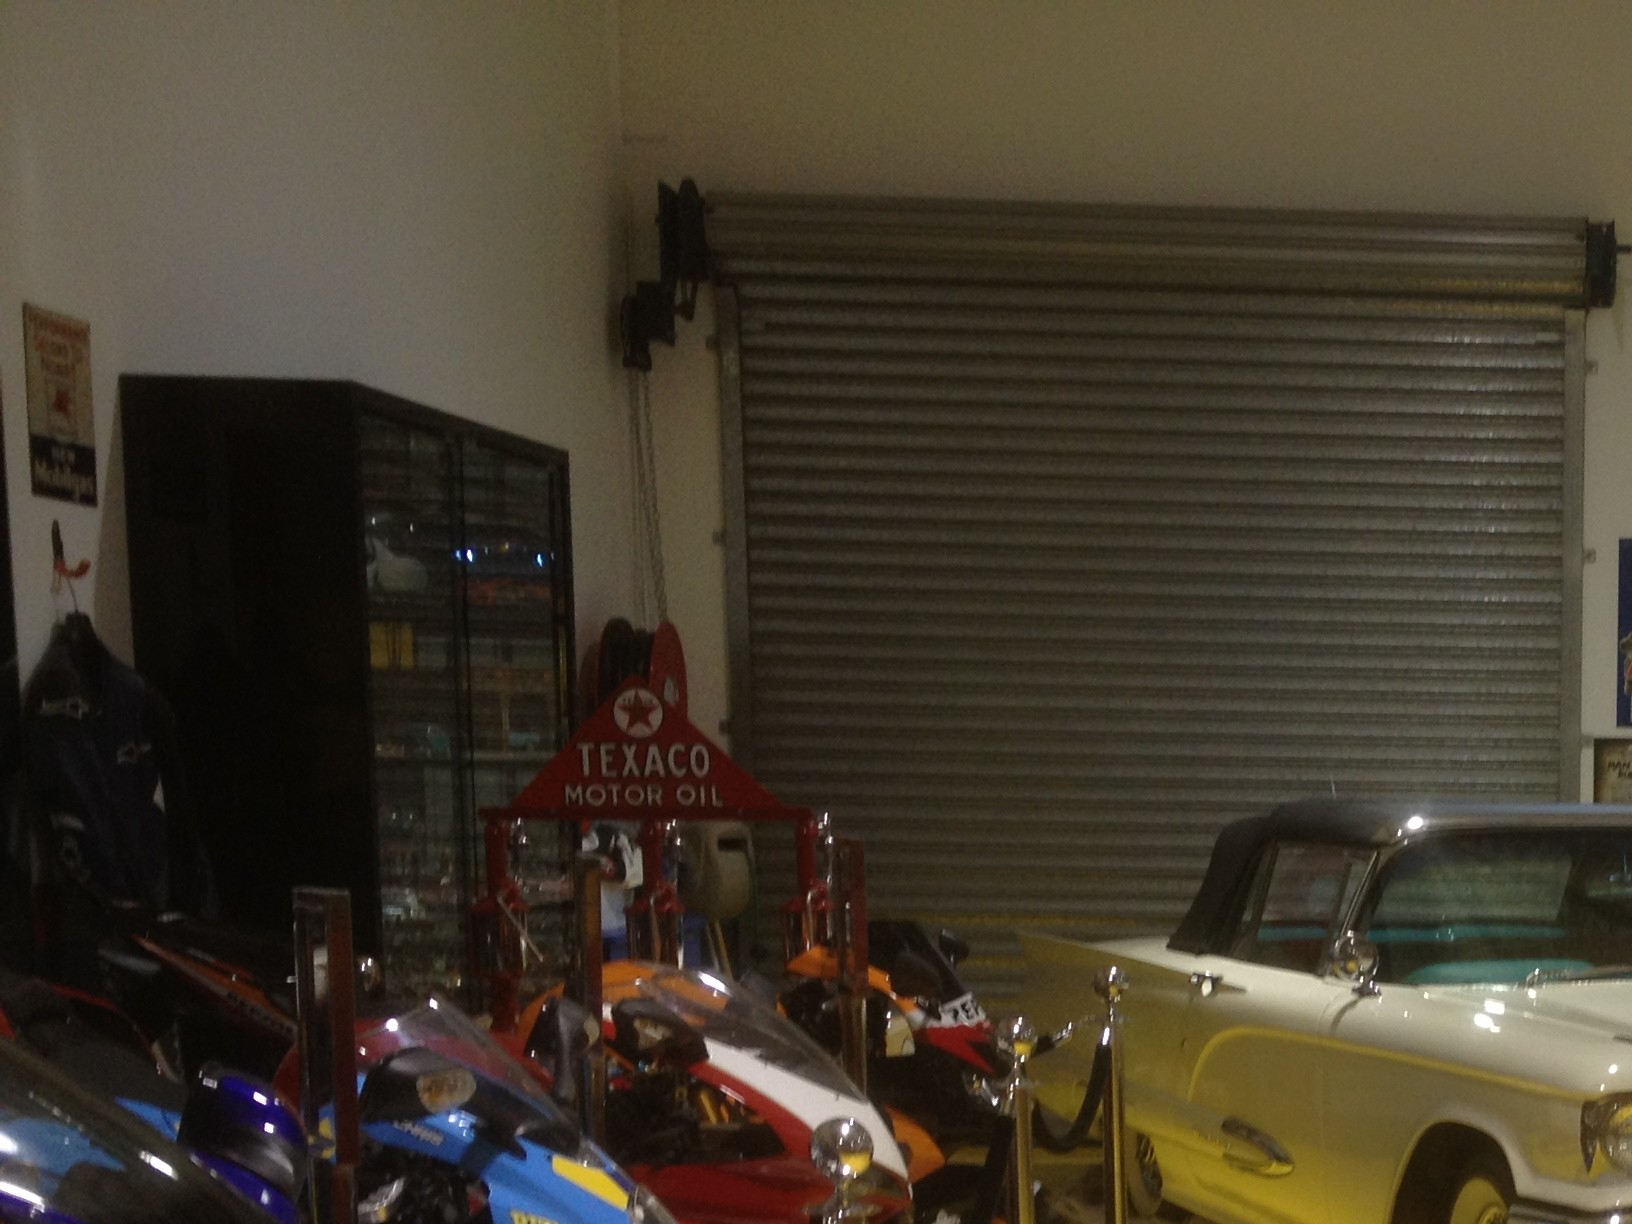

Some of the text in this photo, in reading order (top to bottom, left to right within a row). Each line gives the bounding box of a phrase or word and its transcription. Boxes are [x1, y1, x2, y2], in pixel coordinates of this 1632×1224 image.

[576, 742, 711, 779] TEXACO
[564, 784, 724, 807] MOTOR OIL
